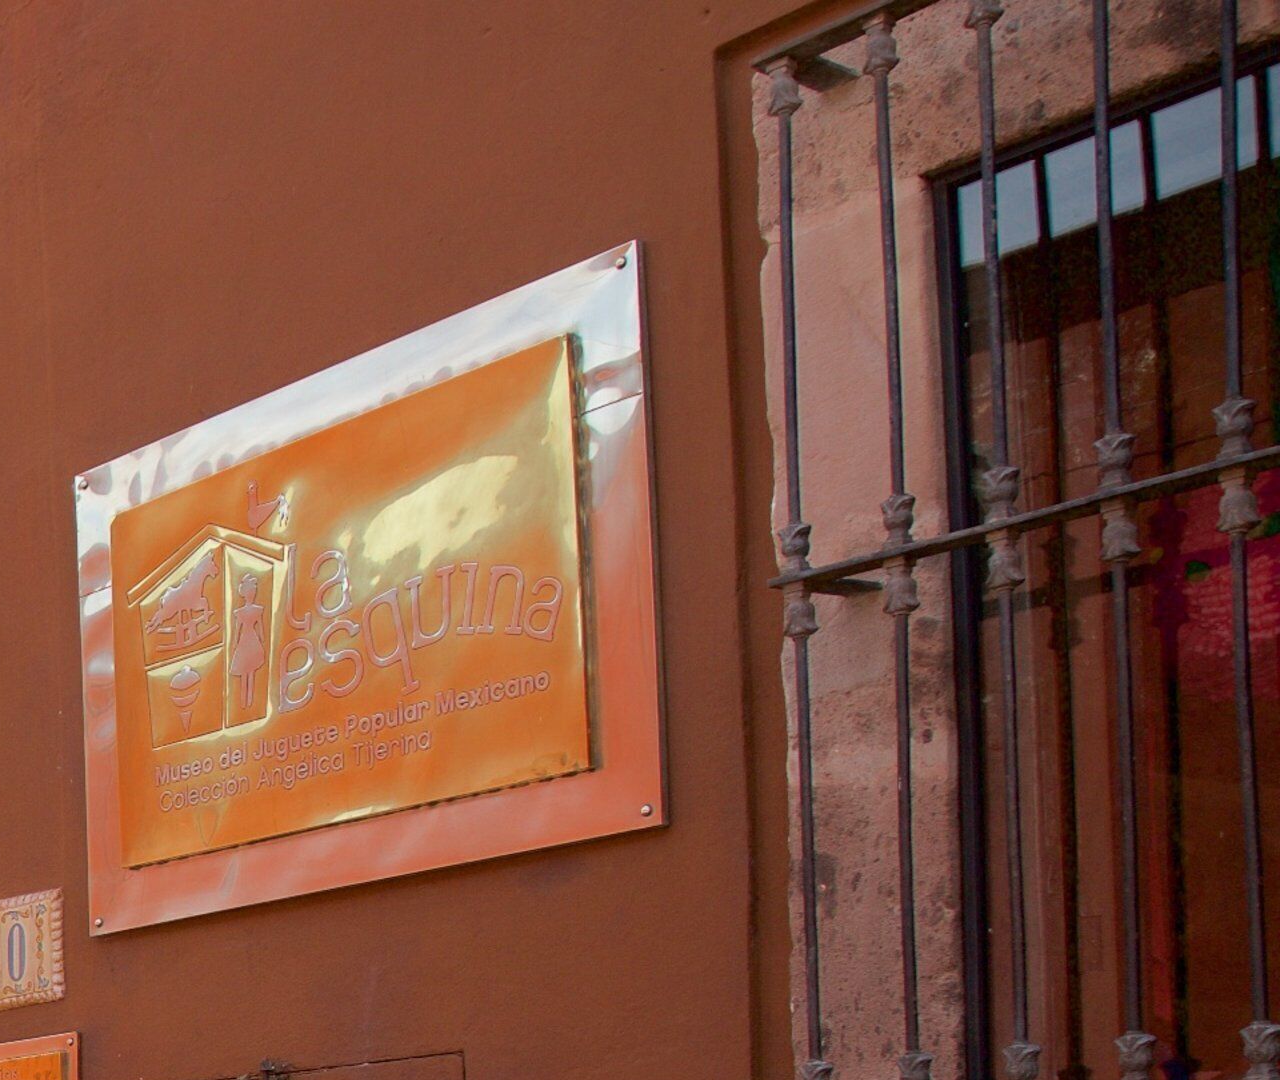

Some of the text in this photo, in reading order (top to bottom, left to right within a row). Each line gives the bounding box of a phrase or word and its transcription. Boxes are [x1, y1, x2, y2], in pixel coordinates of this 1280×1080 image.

[278, 562, 564, 714] esquina
[154, 671, 551, 787] Museo del Juguete Popular Mexicano
[158, 730, 433, 813] Colección Angélica Tijerina
